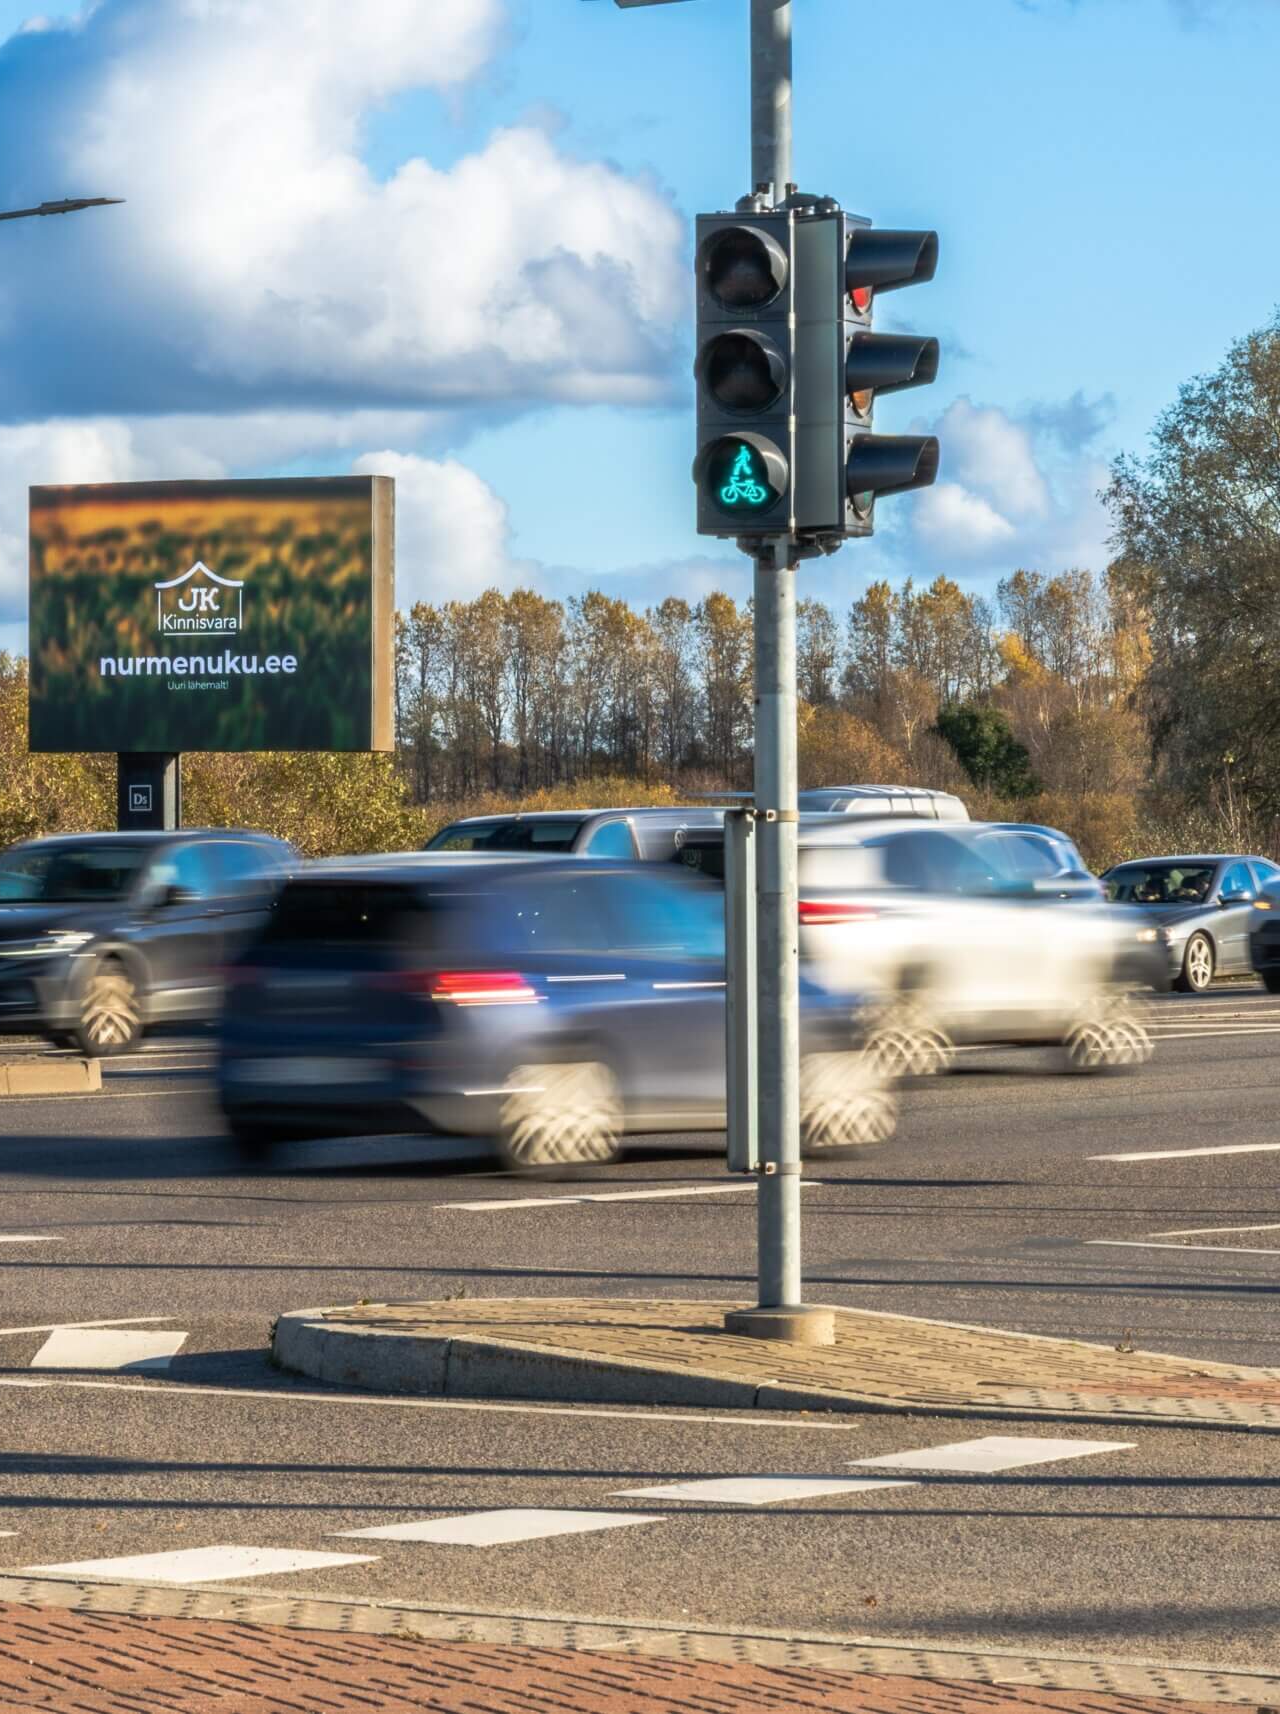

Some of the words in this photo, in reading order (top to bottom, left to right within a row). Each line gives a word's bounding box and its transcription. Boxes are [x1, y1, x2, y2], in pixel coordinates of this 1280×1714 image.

[178, 587, 220, 612] JK
[163, 613, 237, 630] Kinnisvara
[100, 649, 298, 676] nurmenuku.ee
[167, 681, 186, 690] Uuri
